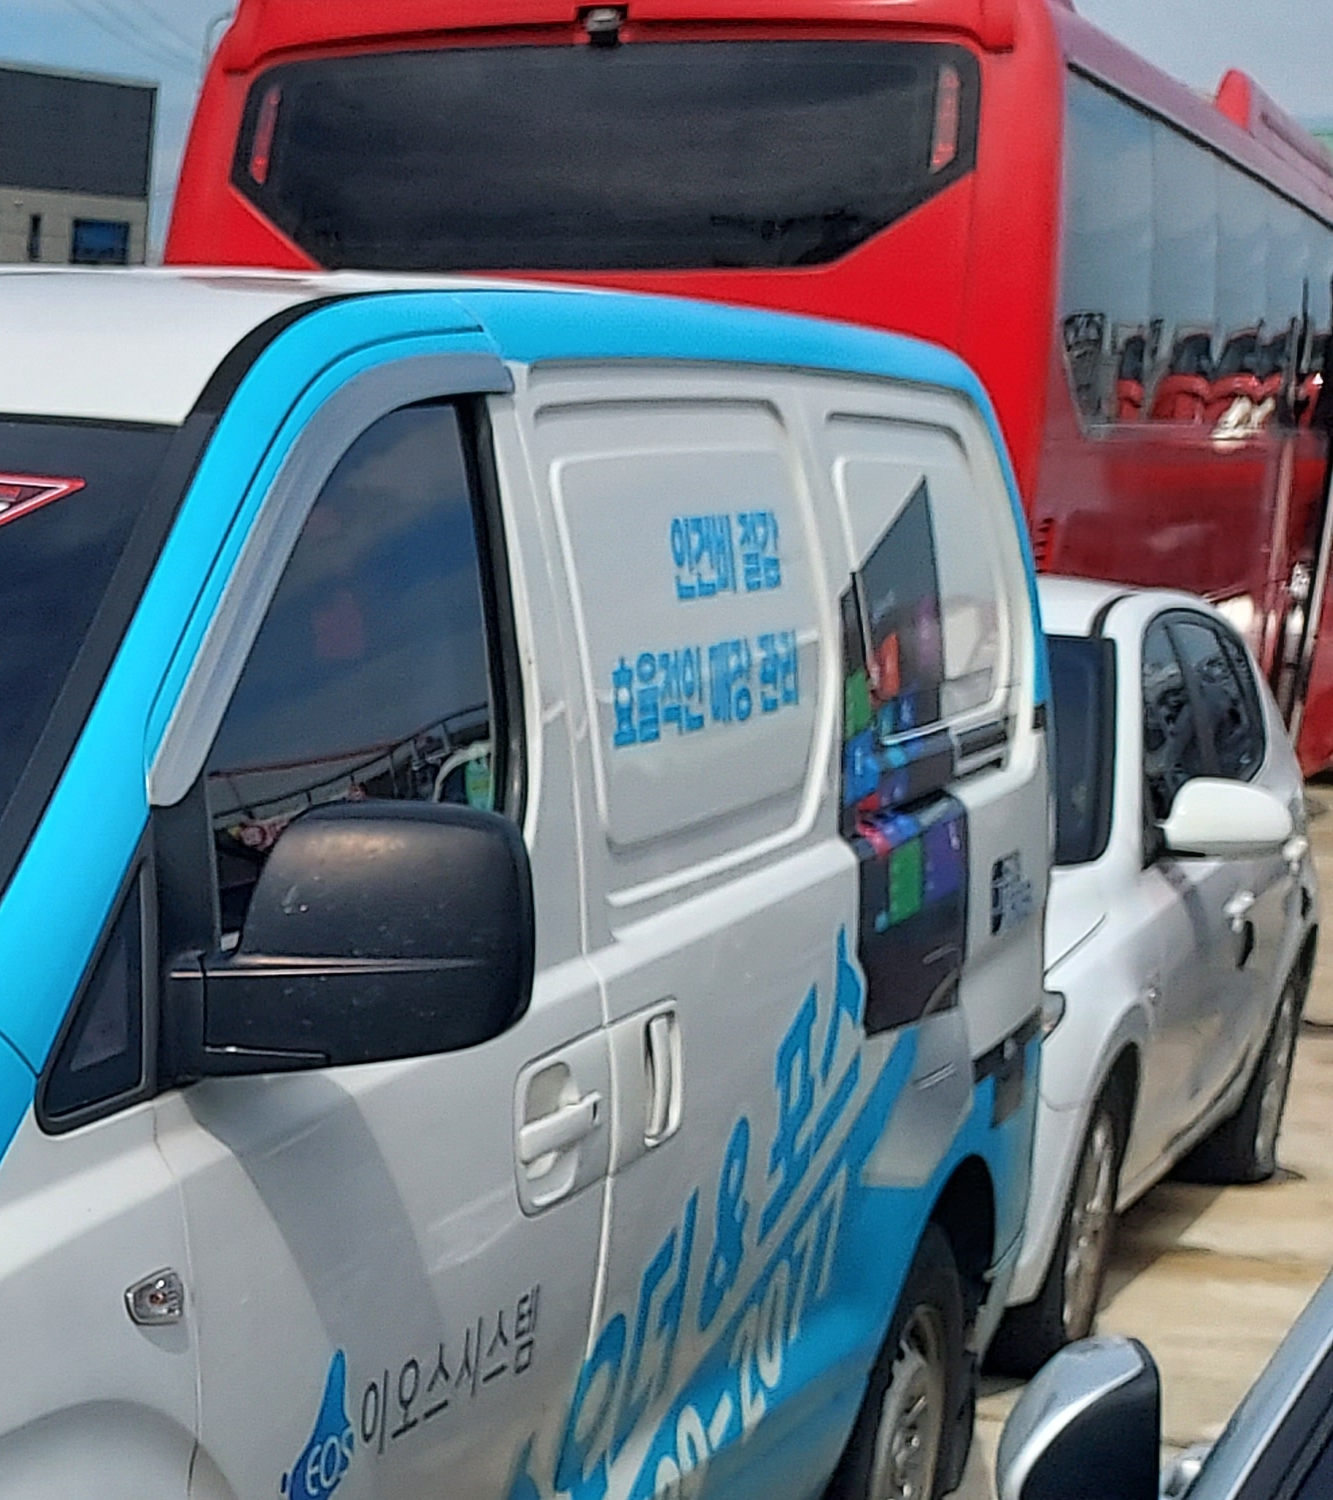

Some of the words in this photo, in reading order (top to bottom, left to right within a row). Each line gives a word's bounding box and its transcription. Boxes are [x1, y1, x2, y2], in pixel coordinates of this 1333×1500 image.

[670, 513, 737, 600] 인건비
[738, 510, 782, 592] 절감
[612, 644, 705, 748] 효율적인
[708, 637, 752, 722] 매장
[757, 629, 800, 712] 관리
[360, 1283, 541, 1456] 이오스시스템
[305, 1434, 355, 1497] EOS
